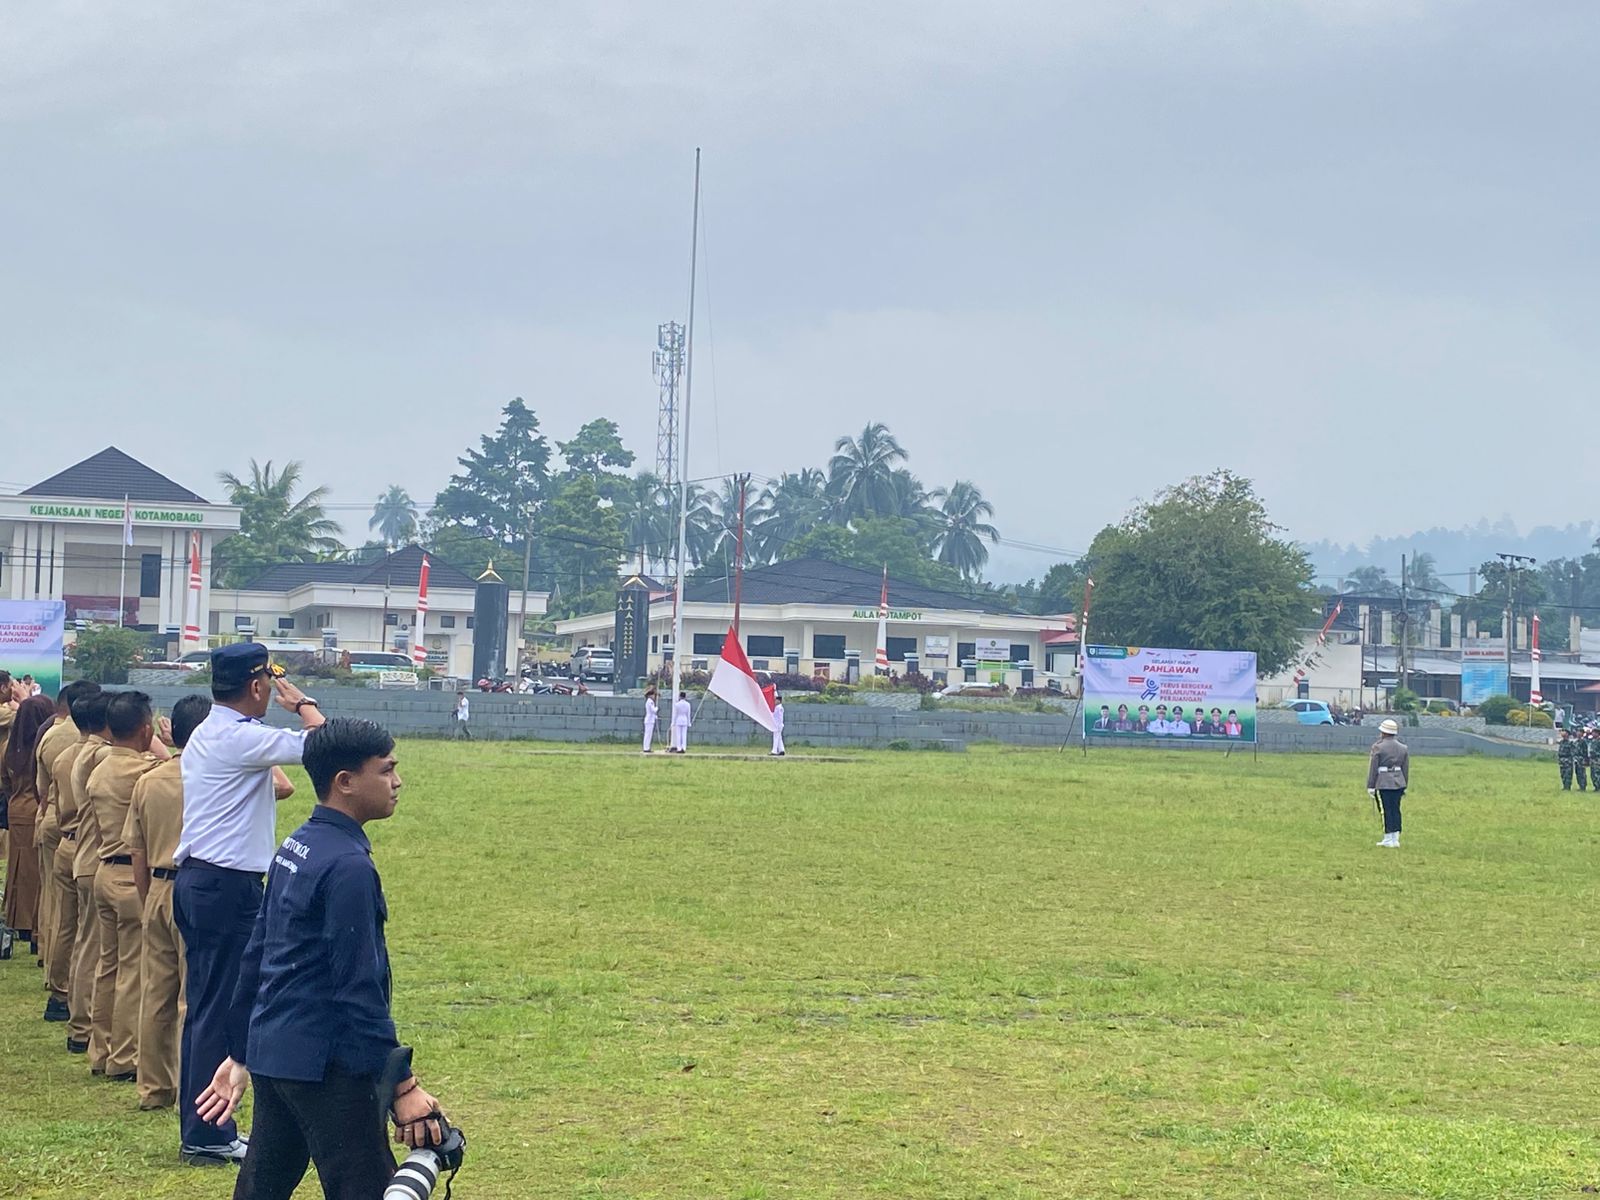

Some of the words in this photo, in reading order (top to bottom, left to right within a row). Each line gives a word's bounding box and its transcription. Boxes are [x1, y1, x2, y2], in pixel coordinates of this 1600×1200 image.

[30, 505, 91, 518] KEJAKSAAN
[95, 509, 131, 520] NEGER
[135, 511, 203, 522] KOTAMOBAGU
[852, 610, 875, 619] AULA
[1143, 665, 1199, 674] PAHLAWAN
